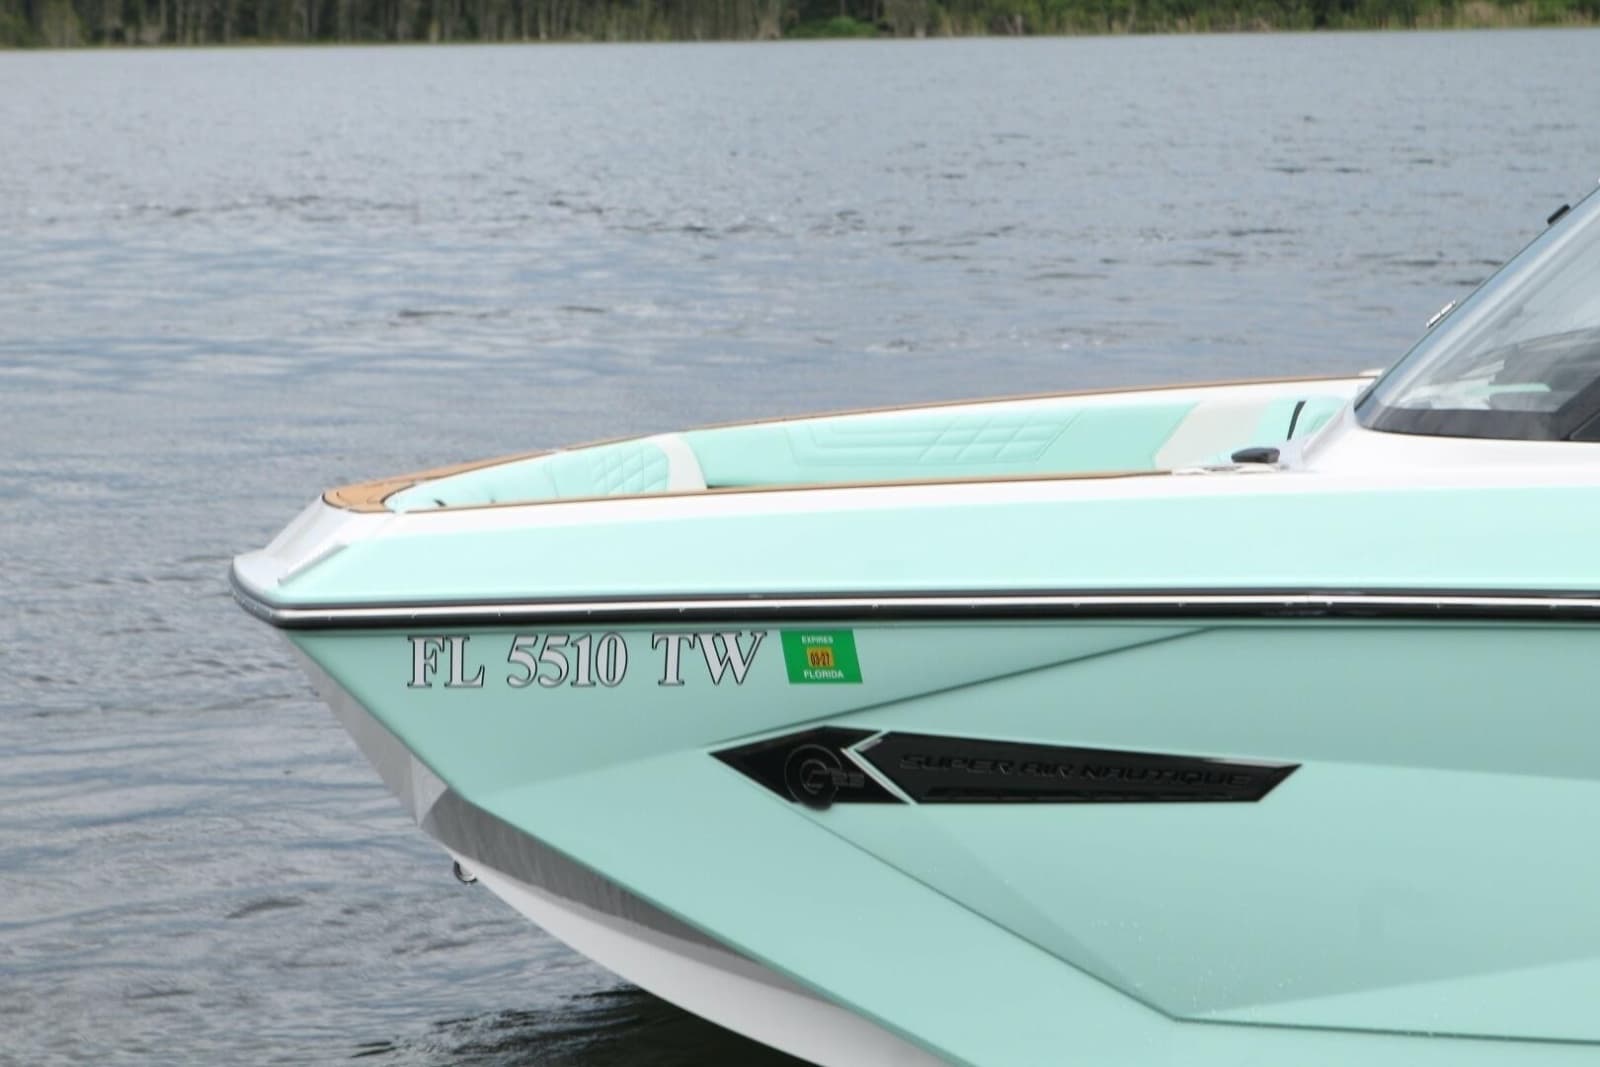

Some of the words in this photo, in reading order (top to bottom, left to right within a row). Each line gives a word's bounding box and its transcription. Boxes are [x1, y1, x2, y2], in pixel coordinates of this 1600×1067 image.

[801, 635, 834, 644] EXPIRES
[407, 635, 485, 688] FL
[506, 632, 628, 688] 5510
[652, 631, 767, 686] TW
[803, 669, 844, 680] FLORIDA
[899, 753, 1014, 776] SUPER
[1019, 759, 1074, 778] AIR
[1079, 764, 1254, 786] NAUTIQUE
